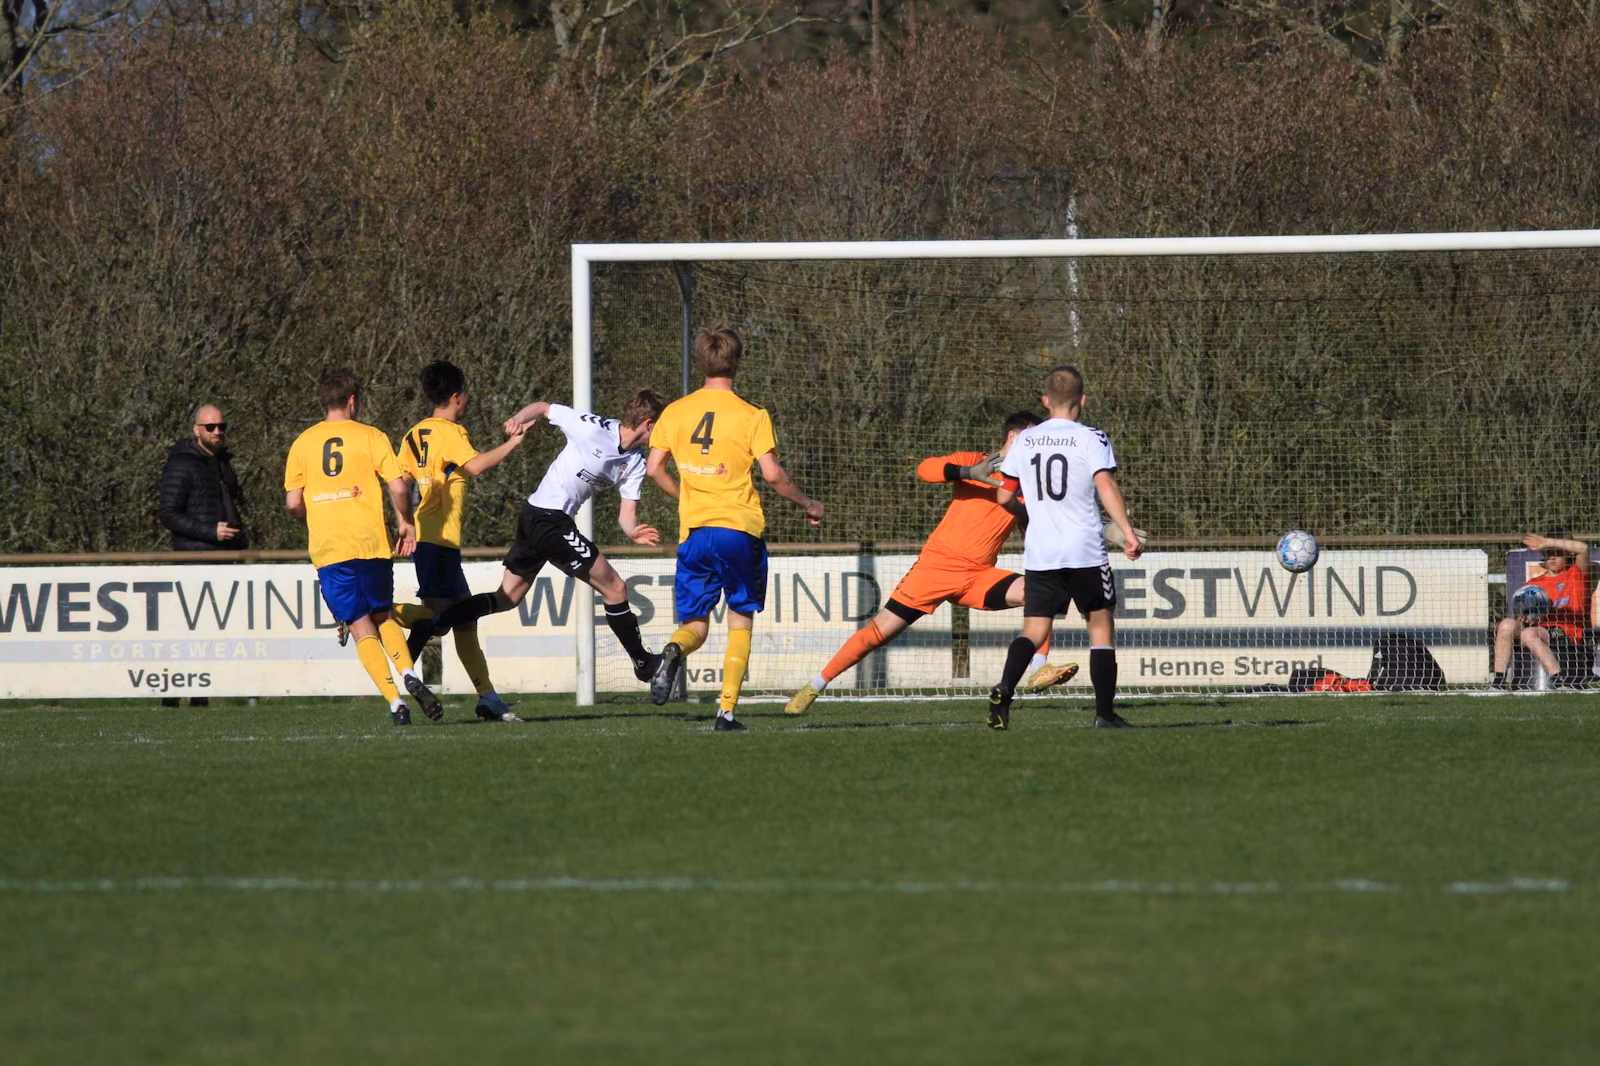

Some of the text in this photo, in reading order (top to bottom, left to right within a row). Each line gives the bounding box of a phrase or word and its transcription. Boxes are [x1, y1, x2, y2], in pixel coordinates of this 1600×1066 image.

[405, 429, 432, 468] 15
[690, 411, 716, 455] 4
[1024, 435, 1078, 449] Sydbank
[322, 436, 344, 477] 6
[1030, 452, 1069, 502] 10
[1112, 565, 1418, 620] ESTWIND
[72, 641, 268, 661] SPORTSWEAR
[1139, 657, 1225, 677] Henne
[128, 668, 211, 693] Vejers
